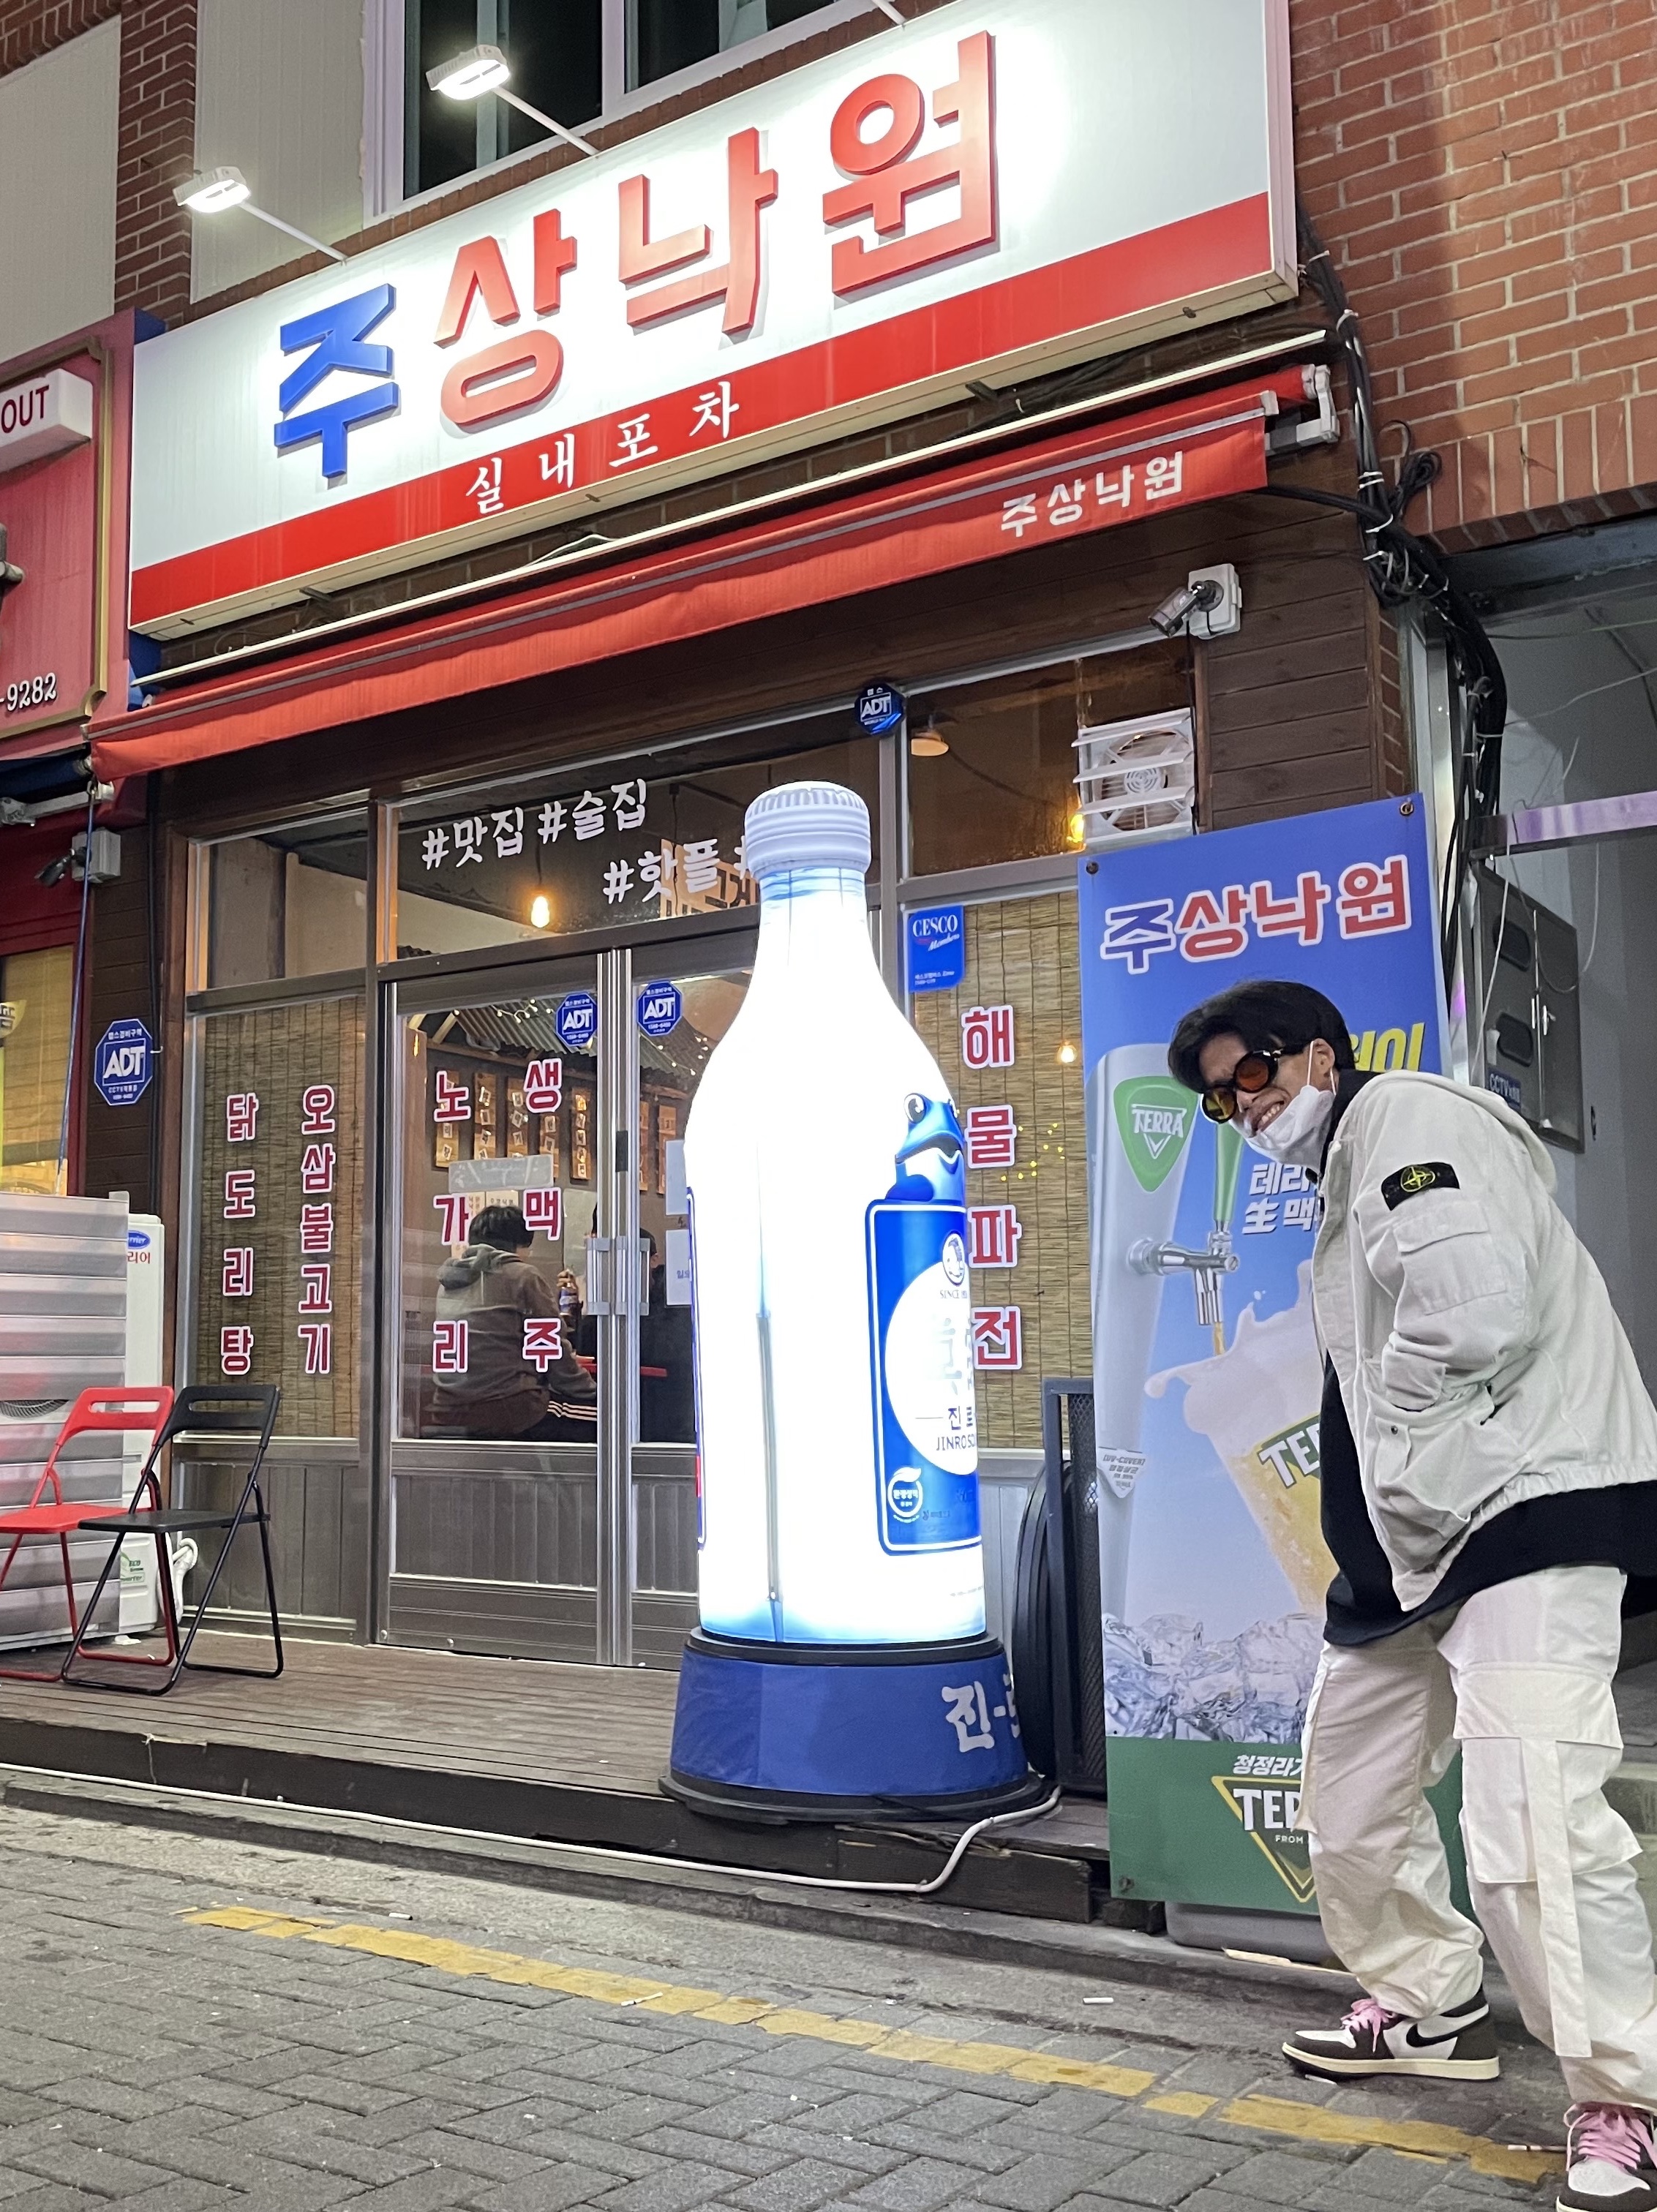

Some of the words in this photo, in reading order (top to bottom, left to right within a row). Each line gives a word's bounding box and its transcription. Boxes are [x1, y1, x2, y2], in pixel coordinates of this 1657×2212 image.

[274, 30, 996, 478] 주상낙원
[1, 384, 49, 433] OUT
[1000, 451, 1184, 538] 주상낙원
[861, 696, 890, 718] ADT
[421, 807, 524, 870] #맛집
[538, 778, 647, 844] #술집
[603, 838, 720, 904] #핫플
[912, 914, 958, 937] CESCO
[1100, 854, 1411, 974] 주상낙원
[563, 1009, 593, 1031] ADT
[644, 997, 675, 1020] ADT
[103, 1046, 145, 1078] ADT
[1131, 1109, 1184, 1138] TERRA
[127, 1252, 151, 1264] 리어
[1275, 1835, 1304, 1844] FROM
